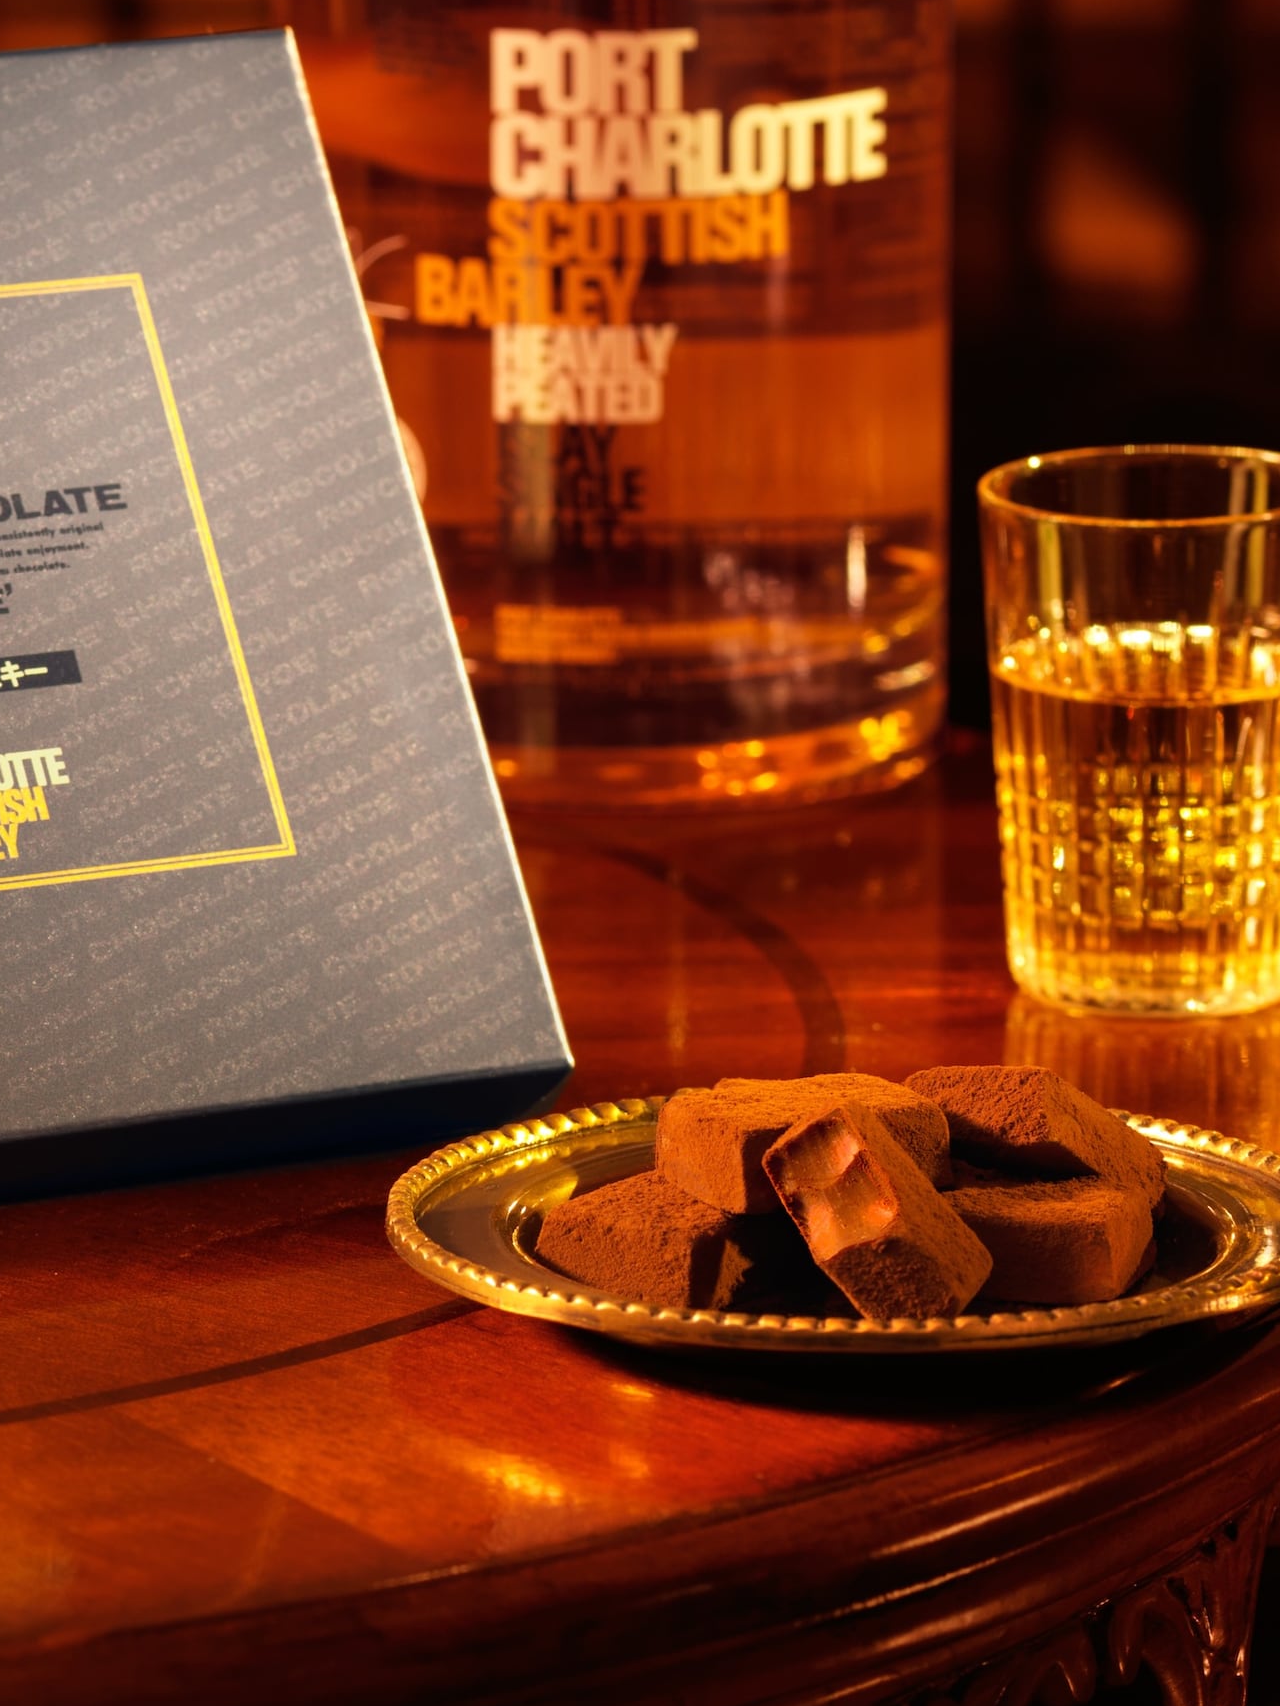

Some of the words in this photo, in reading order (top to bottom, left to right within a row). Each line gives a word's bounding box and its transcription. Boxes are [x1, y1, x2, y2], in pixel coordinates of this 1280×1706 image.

[490, 28, 698, 113] PORT
[490, 86, 888, 200] CHARLOTTE
[488, 189, 790, 268] SCOTTISH
[417, 254, 645, 329] BARLEY
[493, 324, 677, 376] HEAVILY
[493, 373, 665, 424] PEATED
[60, 522, 104, 536] original
